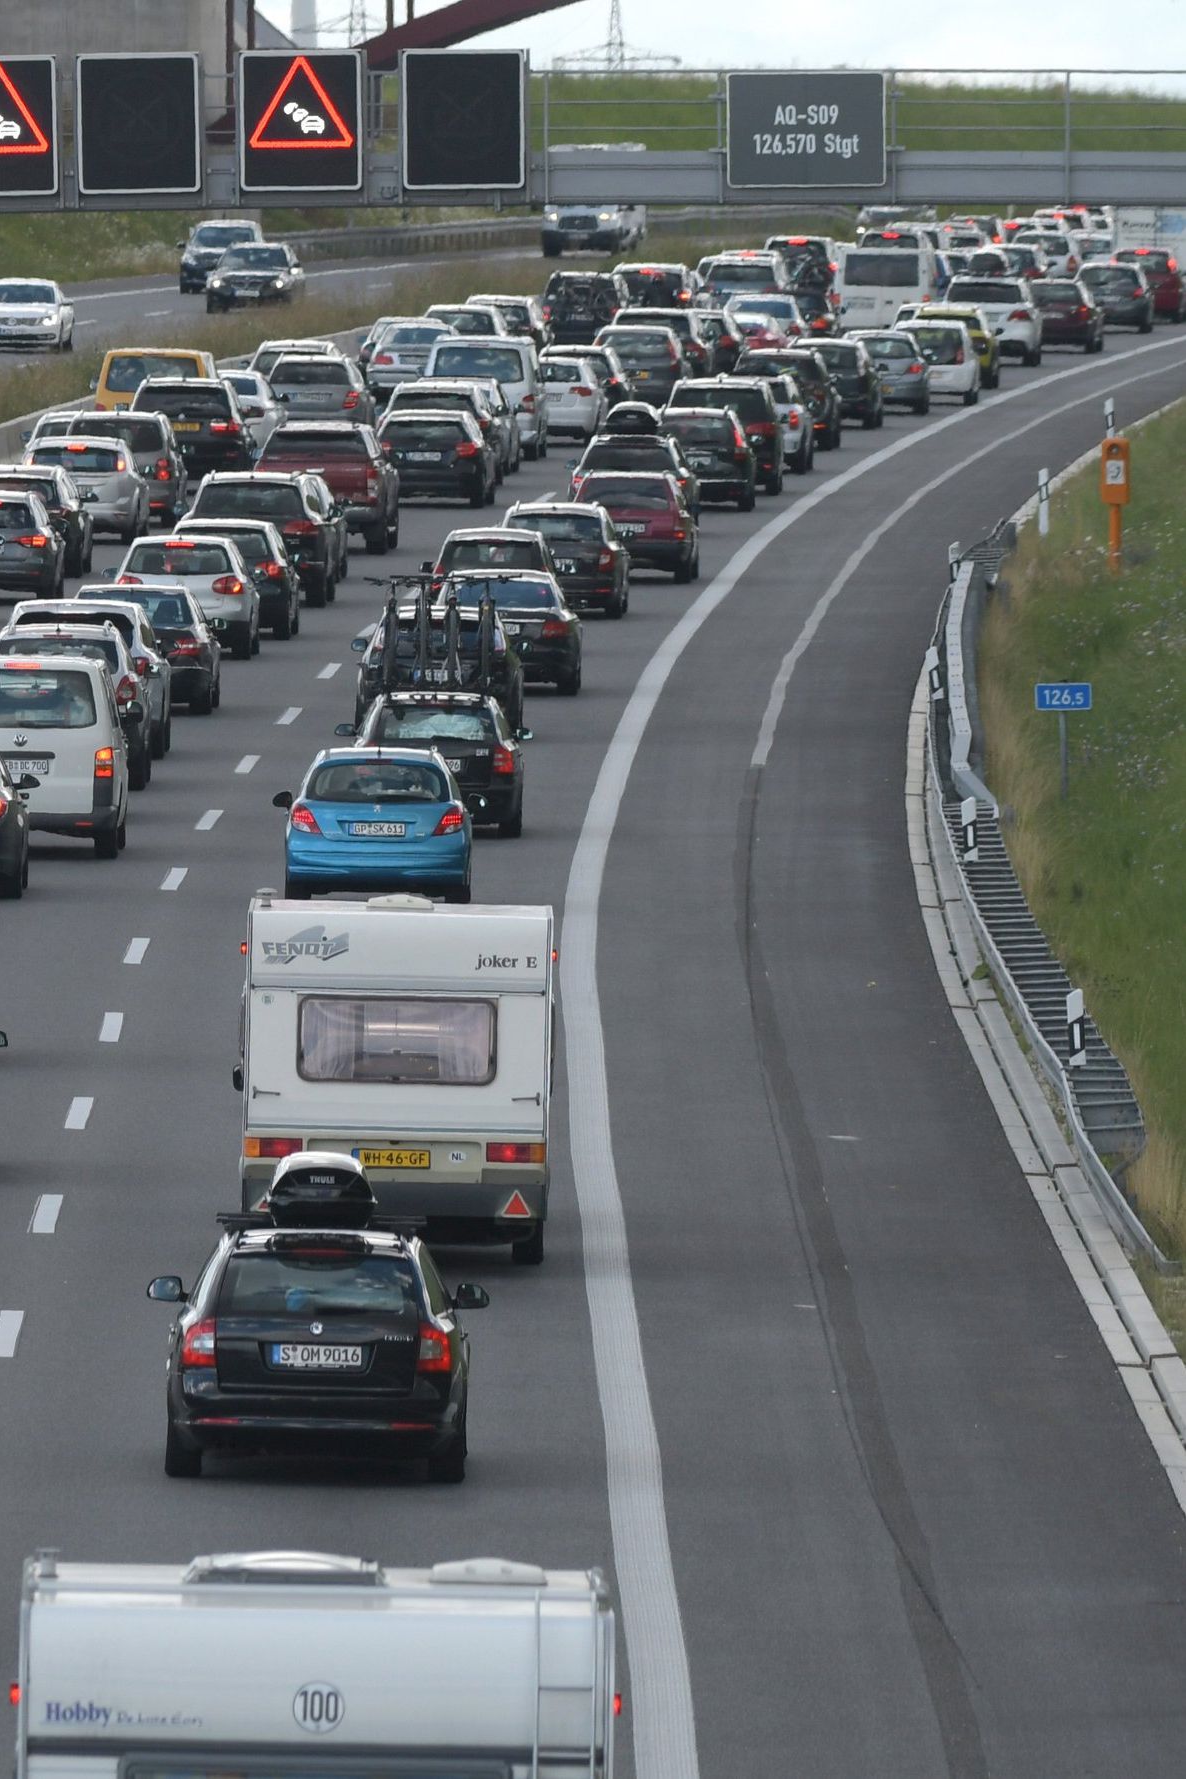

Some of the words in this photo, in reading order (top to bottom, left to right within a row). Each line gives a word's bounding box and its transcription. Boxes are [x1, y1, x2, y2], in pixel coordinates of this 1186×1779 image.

[773, 105, 839, 125] AQ-S09
[752, 133, 816, 156] 126,570
[824, 133, 860, 159] Stgt
[1043, 689, 1084, 706] 126,5
[32, 761, 47, 771] 700
[354, 824, 367, 834] GP
[373, 825, 385, 835] SK
[387, 825, 404, 835] 611
[475, 954, 518, 970] joker
[526, 956, 538, 969] E
[363, 1152, 425, 1165] WH-46-GF
[451, 1152, 464, 1161] NL
[281, 1347, 290, 1361] S
[301, 1348, 321, 1362] OM
[323, 1349, 360, 1363] 9016
[45, 1701, 111, 1728] Hobby
[299, 1690, 338, 1724] 100
